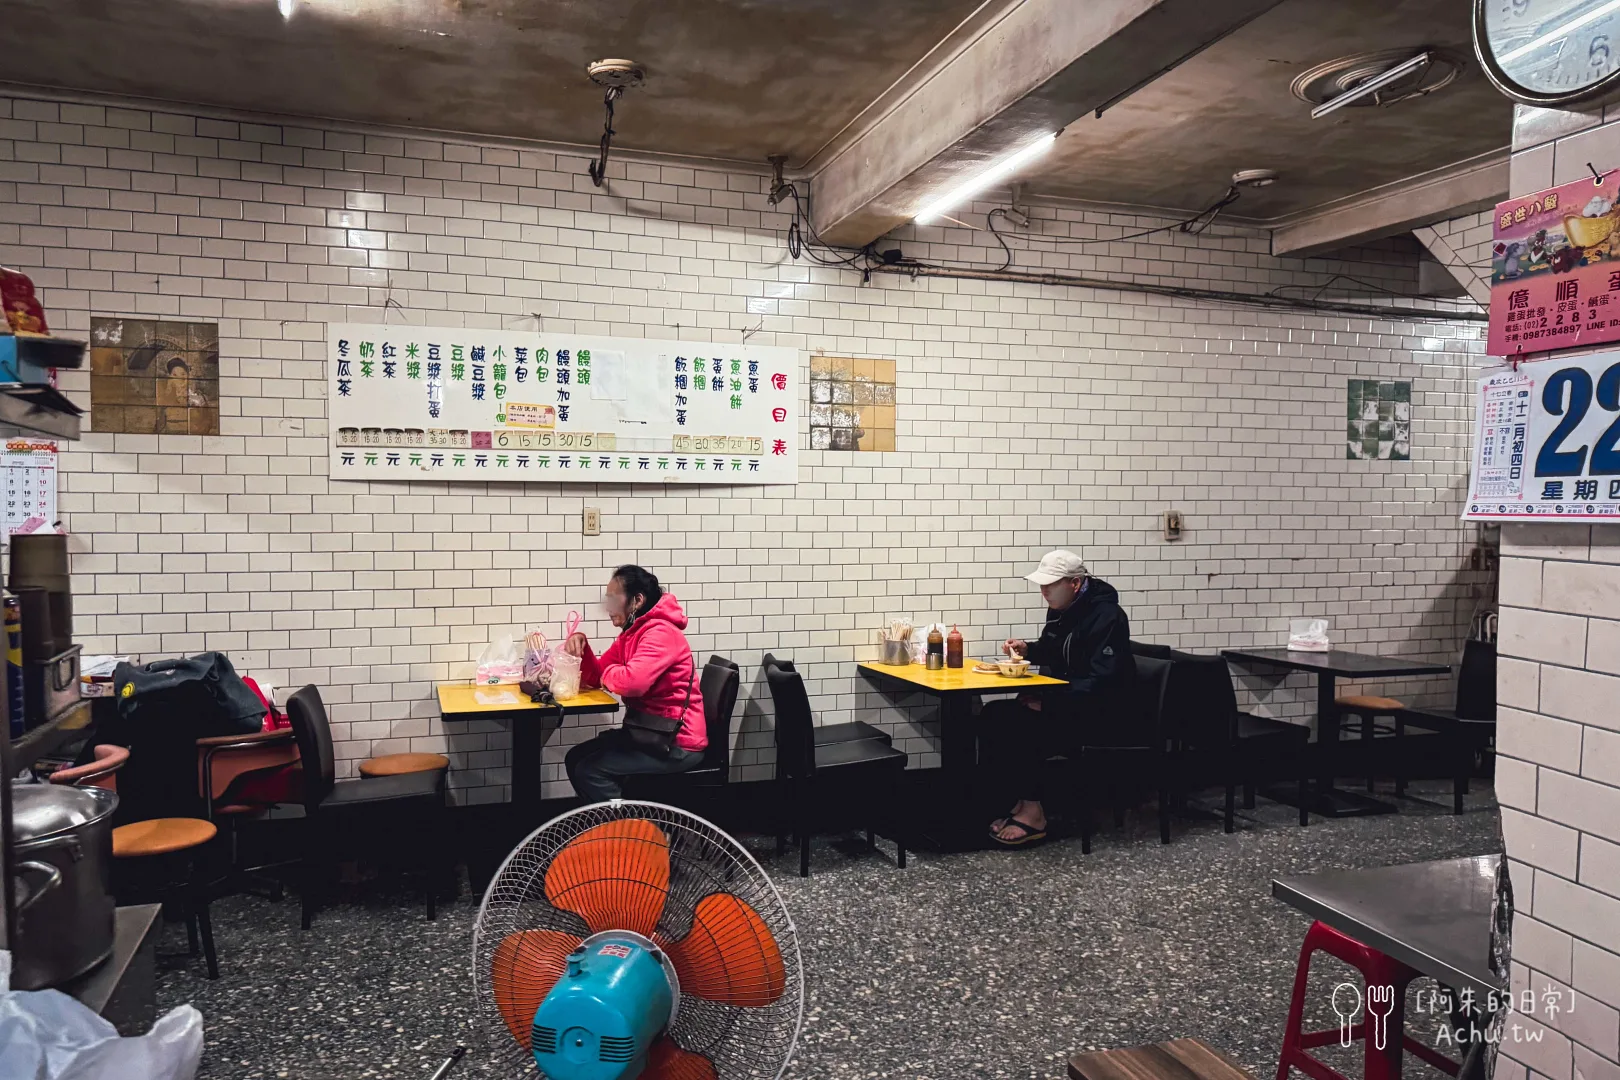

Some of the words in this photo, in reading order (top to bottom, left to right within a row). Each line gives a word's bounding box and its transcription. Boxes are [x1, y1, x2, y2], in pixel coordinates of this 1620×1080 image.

[1589, 34, 1610, 66] 6
[1523, 324, 1581, 340] 0987384897
[1586, 320, 1605, 330] LINE
[337, 339, 352, 396] 冬瓜茶
[359, 341, 375, 378] 奶茶
[382, 342, 397, 378] 紅茶
[405, 342, 421, 379] 米漿
[451, 344, 465, 380] 豆漿
[493, 345, 507, 399] 小籠包
[514, 347, 528, 383] 菜包
[536, 347, 549, 382] 肉包
[577, 349, 591, 385] 饅頭
[712, 358, 724, 392] 蛋餅
[427, 343, 441, 418] 豆漿打蛋
[556, 349, 570, 422] 饅頭加蛋
[771, 373, 787, 455] 價目表
[386, 436, 392, 444] 15
[407, 436, 413, 444] 15
[499, 432, 509, 447] 6
[519, 435, 531, 447] 15
[538, 433, 551, 446] 15
[560, 433, 574, 446] 30
[580, 435, 592, 447] 15
[675, 436, 690, 449] 45
[695, 438, 708, 450] 30
[712, 438, 725, 449] 35
[750, 439, 761, 451] 15
[1509, 400, 1529, 479] 十二月初四日
[341, 452, 355, 465] 元
[364, 453, 378, 466] 元
[386, 453, 400, 466] 元
[408, 453, 422, 466] 元
[430, 454, 444, 466] 元
[452, 454, 466, 467] 元
[474, 455, 488, 467] 元
[496, 455, 509, 468] 元
[516, 455, 530, 468] 元
[537, 456, 550, 468] 元
[558, 456, 571, 468] 元
[579, 456, 591, 469] 元
[598, 457, 611, 469] 元
[618, 457, 630, 469] 元
[638, 458, 650, 469] 元
[657, 458, 669, 470] 元
[676, 458, 688, 470] 元
[694, 458, 706, 470] 元
[713, 459, 724, 471] 元
[731, 459, 742, 471] 元
[748, 460, 759, 471] 元
